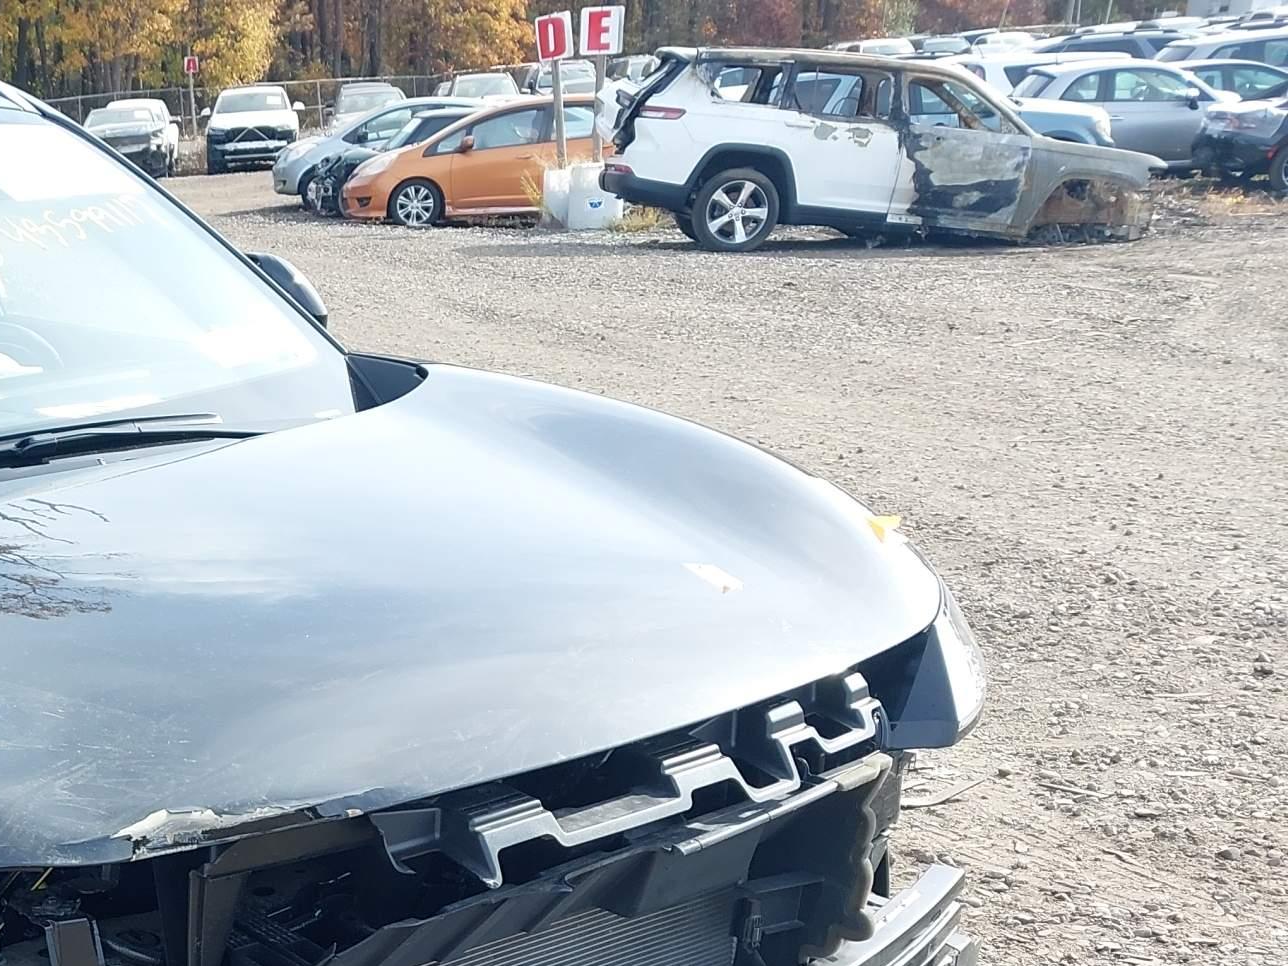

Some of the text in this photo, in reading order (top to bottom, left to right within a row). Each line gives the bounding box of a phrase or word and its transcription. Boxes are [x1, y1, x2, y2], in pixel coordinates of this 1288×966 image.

[538, 17, 567, 59] D
[587, 10, 611, 50] E
[186, 58, 197, 71] A
